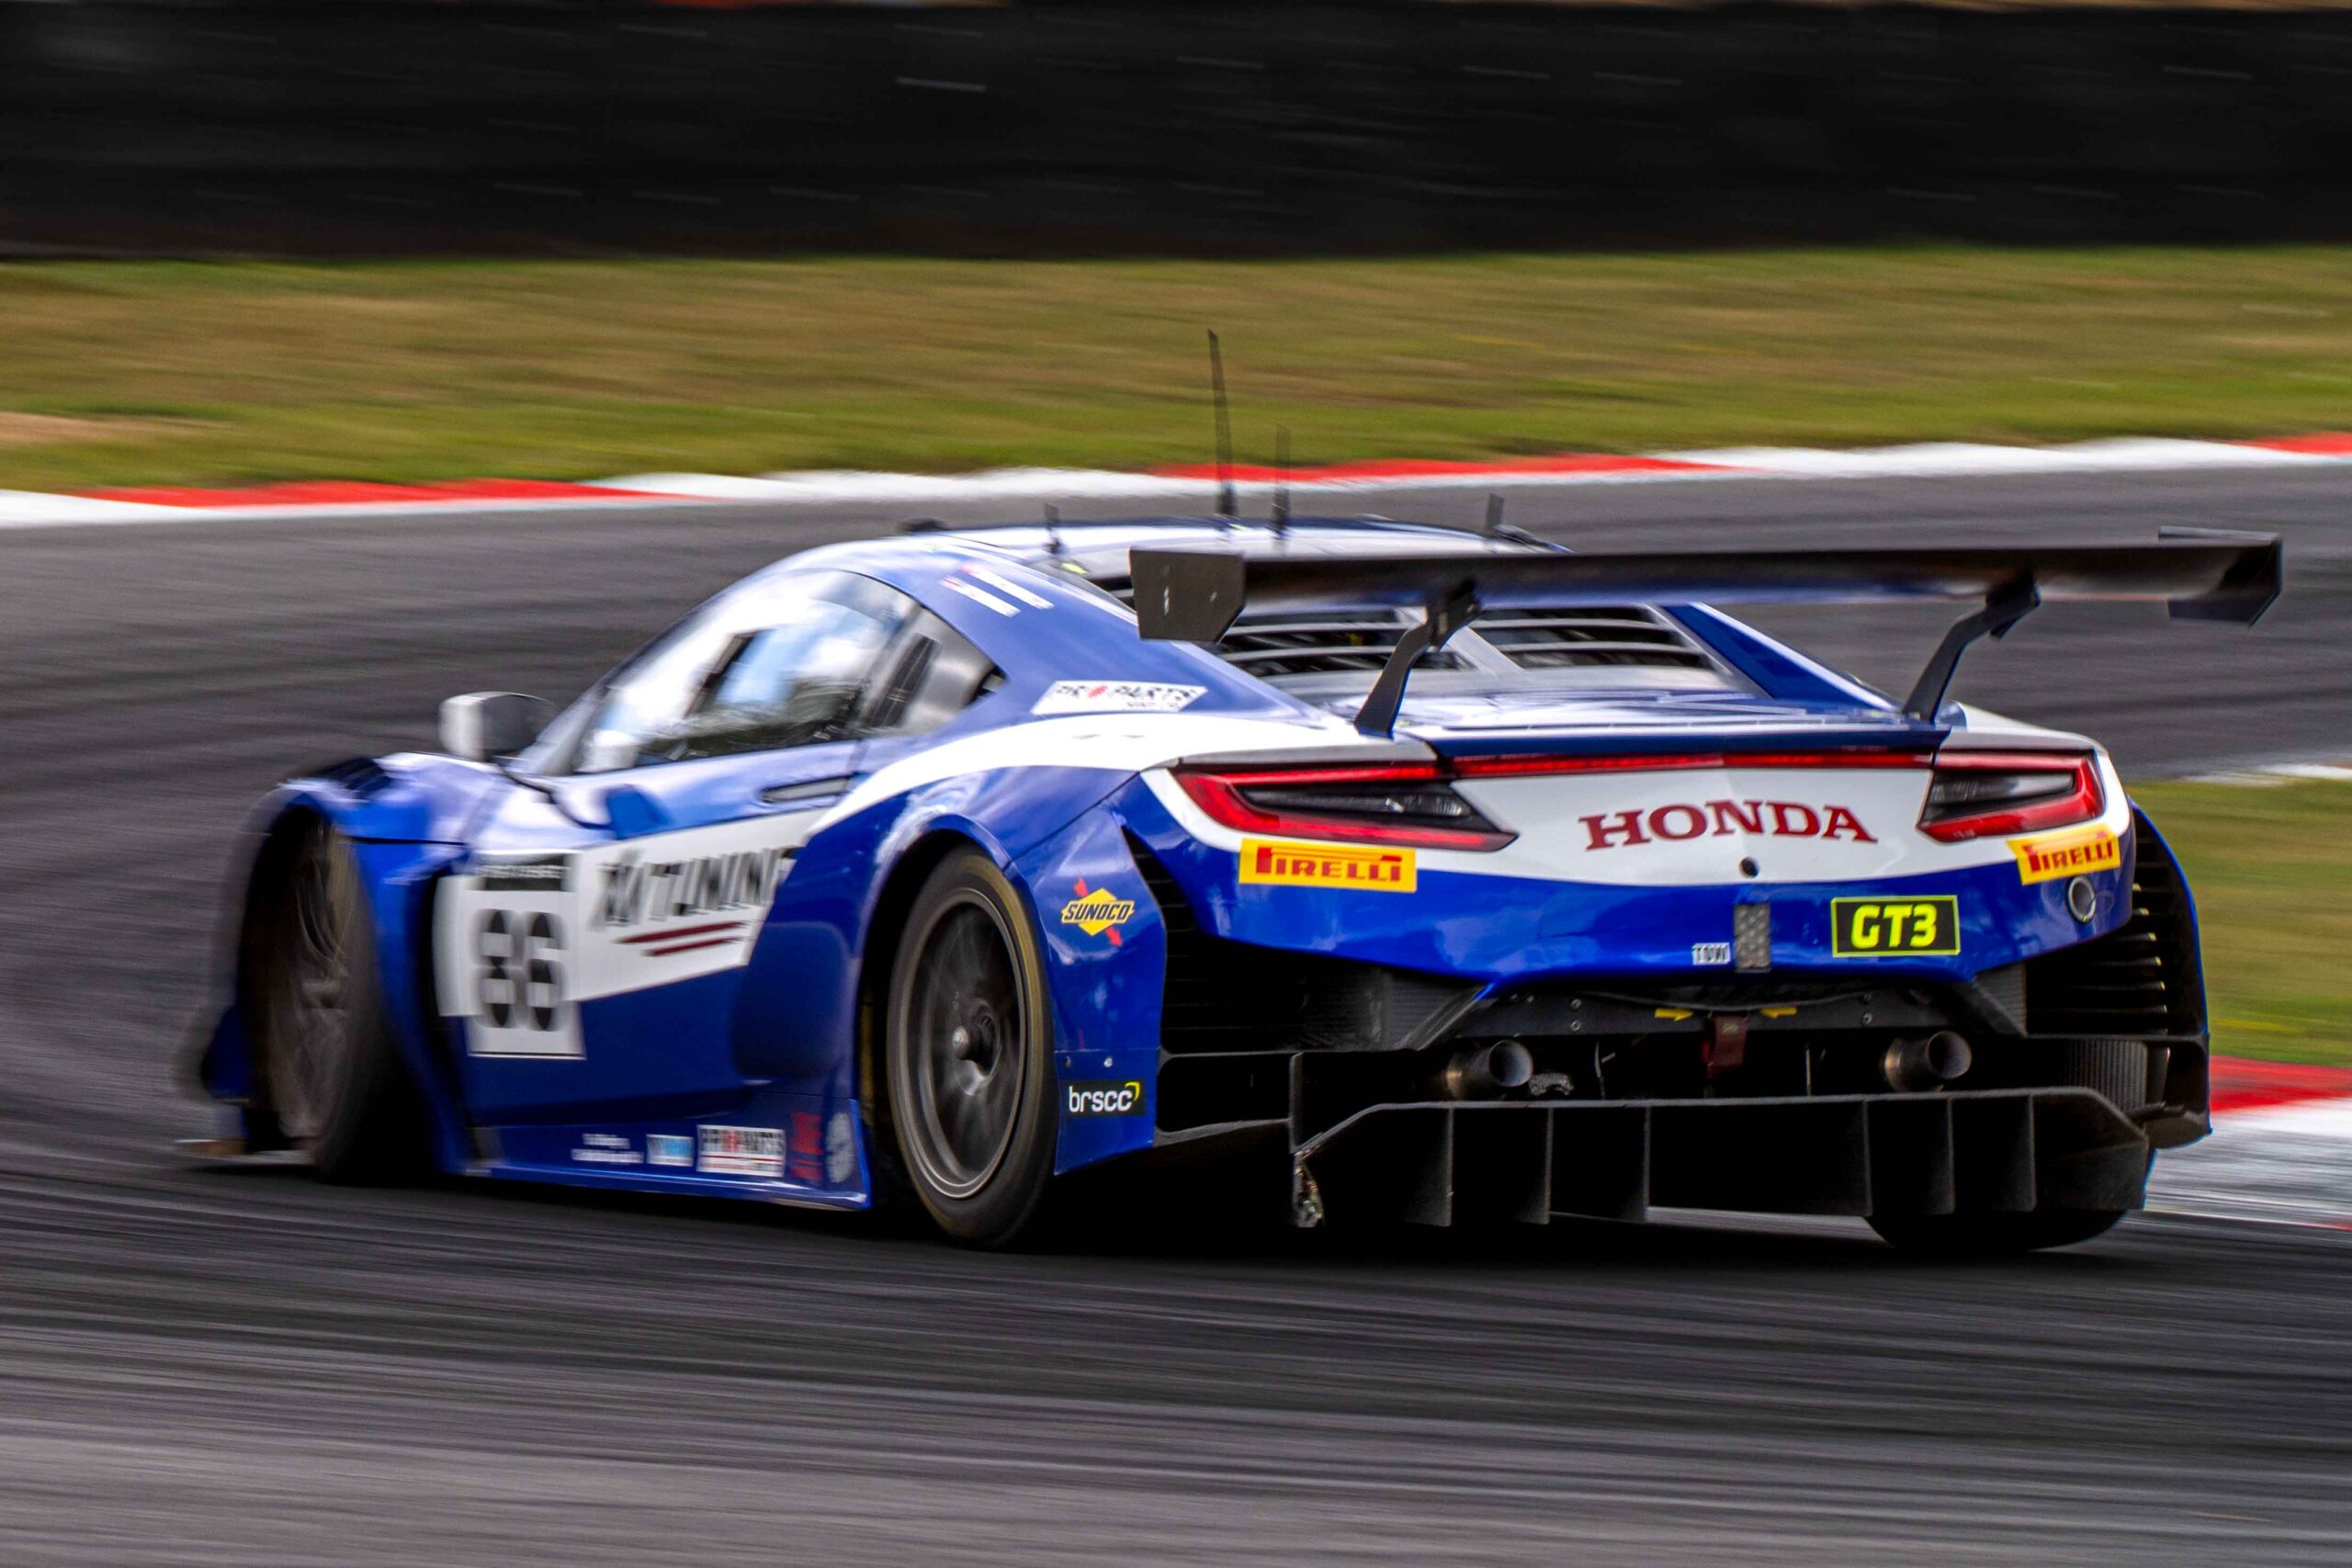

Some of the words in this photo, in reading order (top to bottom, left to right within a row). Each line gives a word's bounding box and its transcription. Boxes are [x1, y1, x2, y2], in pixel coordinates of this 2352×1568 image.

[1578, 800, 1878, 852] HONDA
[1256, 846, 1402, 882] PIRELLI
[2021, 830, 2112, 874] PIRELLI
[1065, 900, 1131, 922] SUNOCO
[1849, 903, 1938, 949] GT3
[1069, 1086, 1133, 1112] brscc
